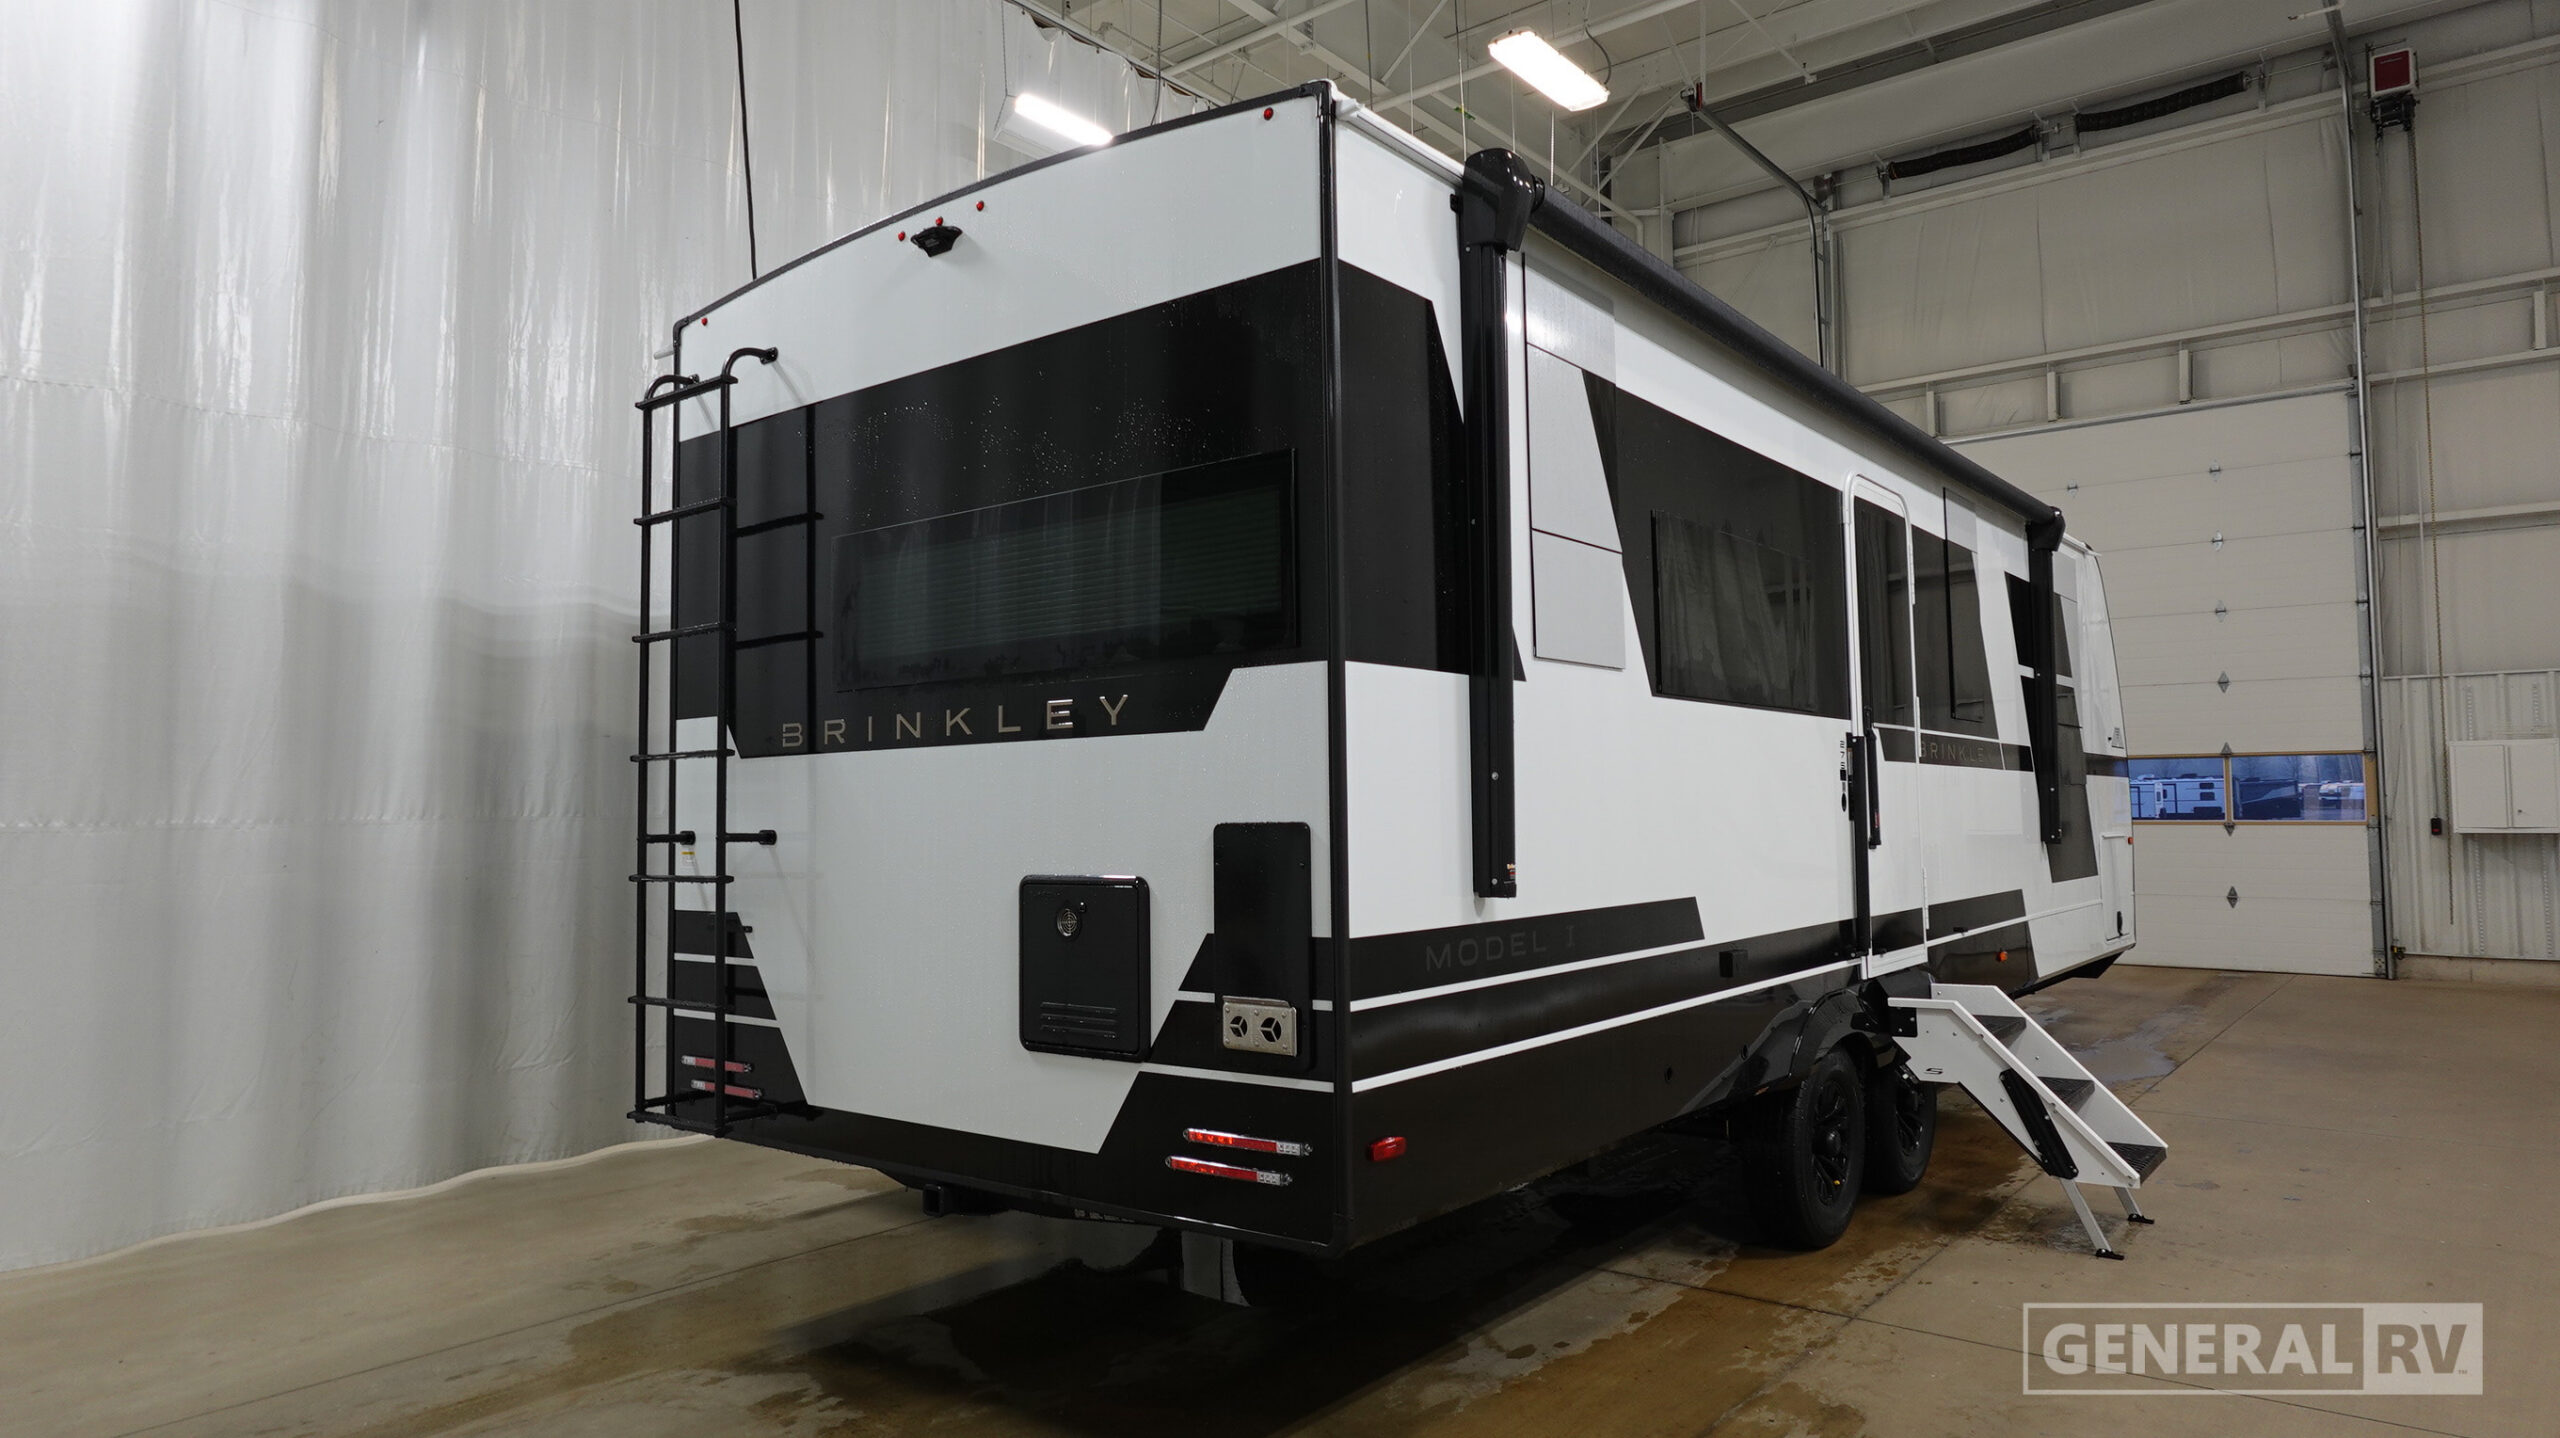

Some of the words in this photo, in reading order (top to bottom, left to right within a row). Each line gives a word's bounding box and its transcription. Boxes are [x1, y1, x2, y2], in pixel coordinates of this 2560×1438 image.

[781, 693, 1129, 748] BRINKLEY
[1920, 740, 1994, 765] BRINKLE
[1425, 930, 1548, 972] MODEL
